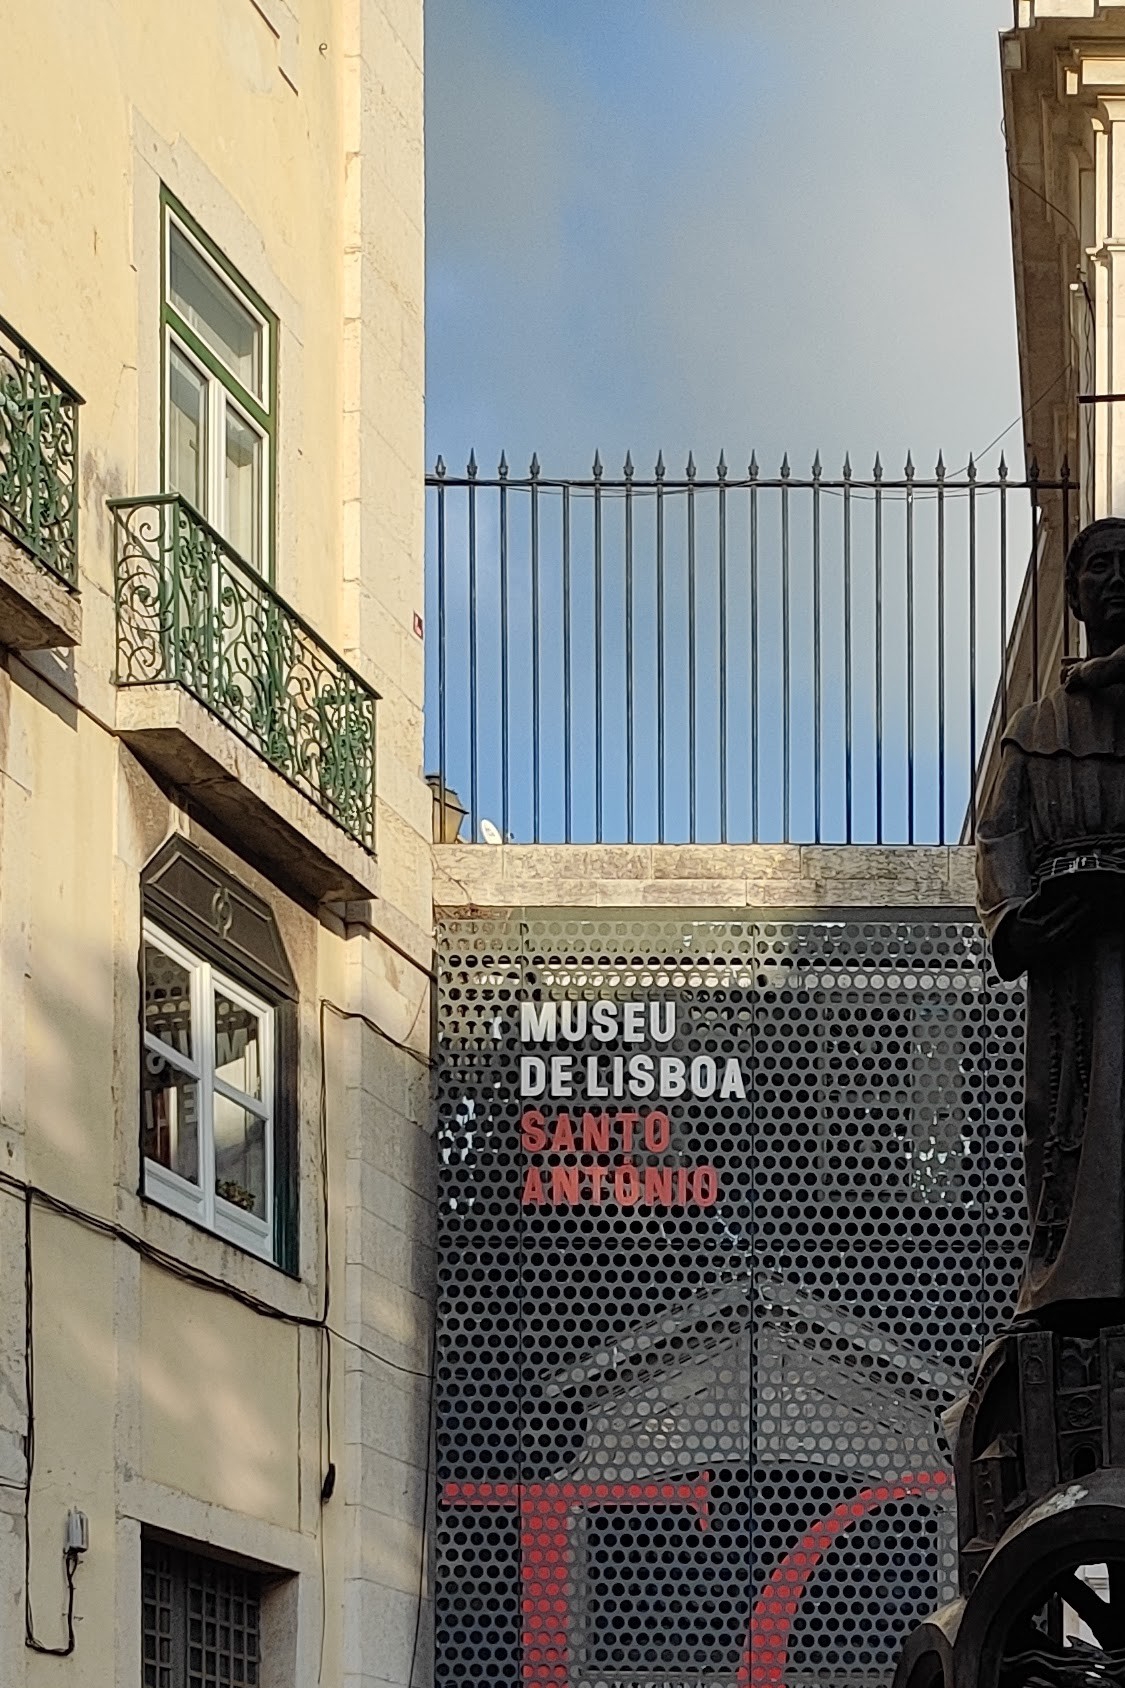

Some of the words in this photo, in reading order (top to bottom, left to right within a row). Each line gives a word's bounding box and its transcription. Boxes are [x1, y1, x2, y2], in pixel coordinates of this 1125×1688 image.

[519, 1000, 677, 1043] MUSEU
[519, 1056, 573, 1097] DE
[587, 1055, 747, 1099] LISBOA
[520, 1111, 671, 1154] SANTO
